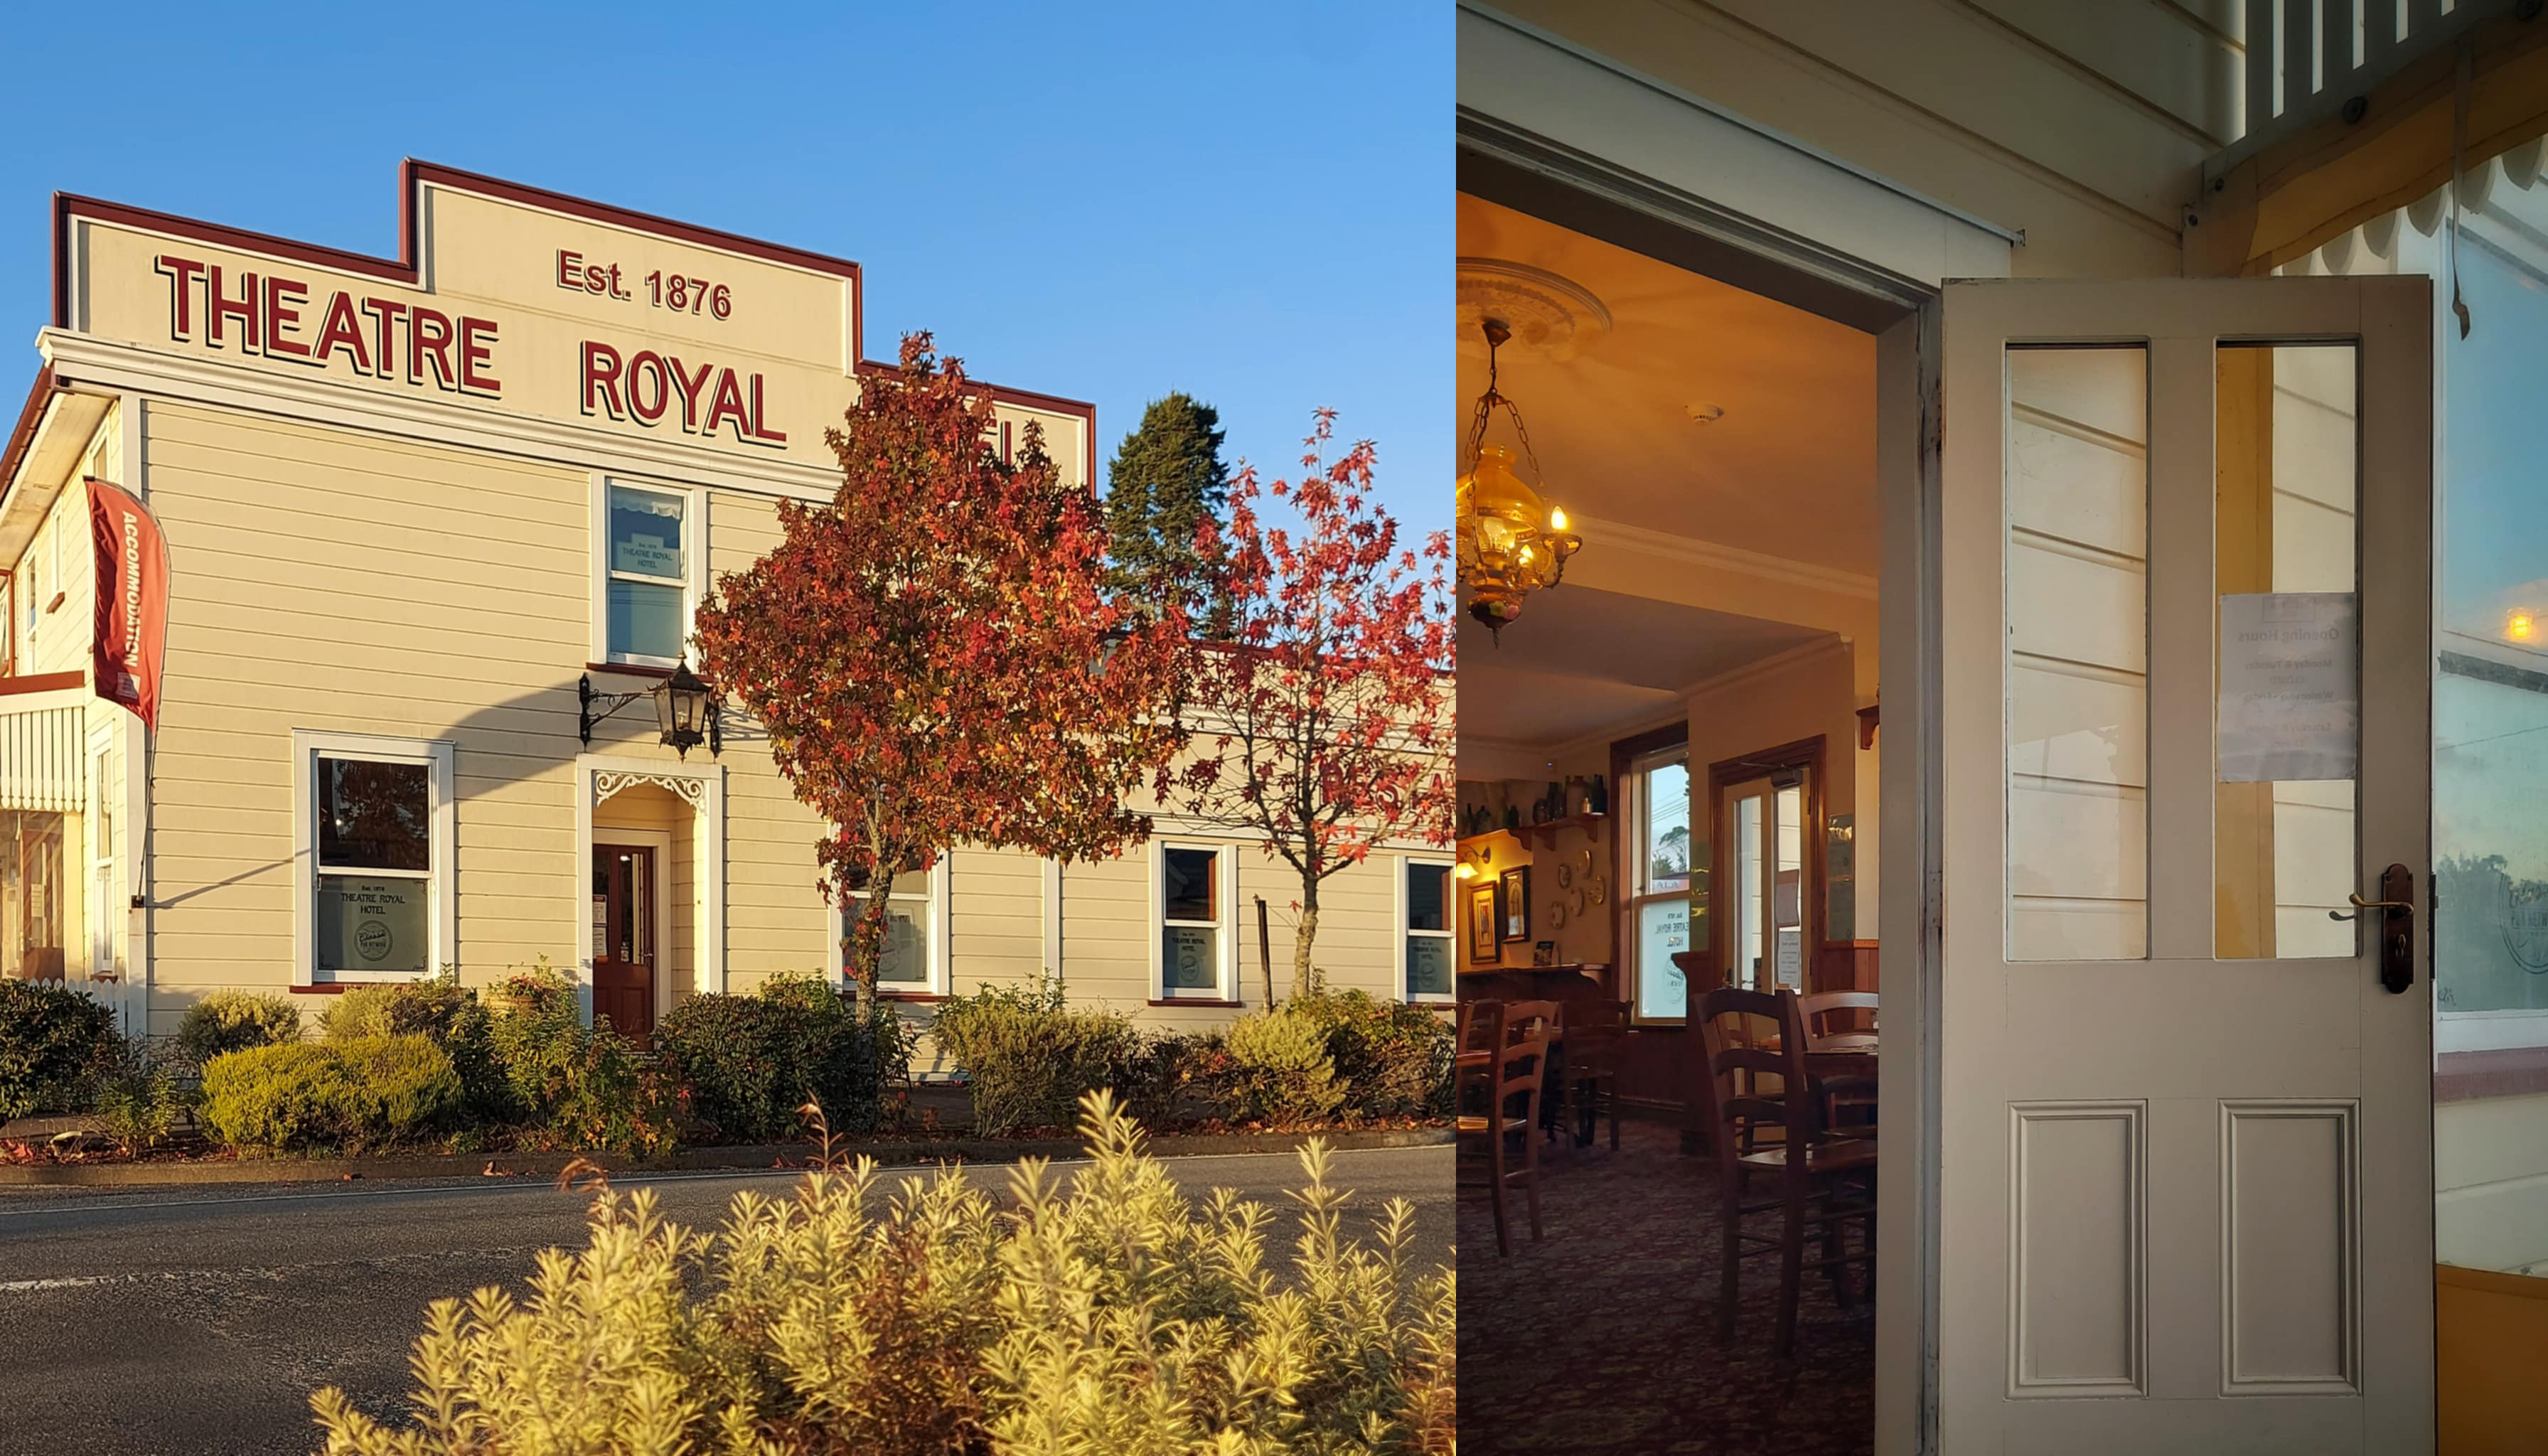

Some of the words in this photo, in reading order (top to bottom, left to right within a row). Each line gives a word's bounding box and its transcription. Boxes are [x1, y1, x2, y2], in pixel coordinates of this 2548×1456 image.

[557, 248, 632, 301] Est.
[645, 269, 732, 321] 1876
[154, 255, 502, 400] THEATRE
[580, 340, 788, 450] ROYAL
[623, 547, 651, 558] THEATRE
[652, 552, 673, 561] ROYAL
[638, 560, 658, 569] HOTEL
[122, 510, 141, 668] ACCOMMODATION
[341, 893, 376, 903] THEATRE
[380, 894, 406, 904] ROYAL
[360, 905, 386, 915] HOTEL
